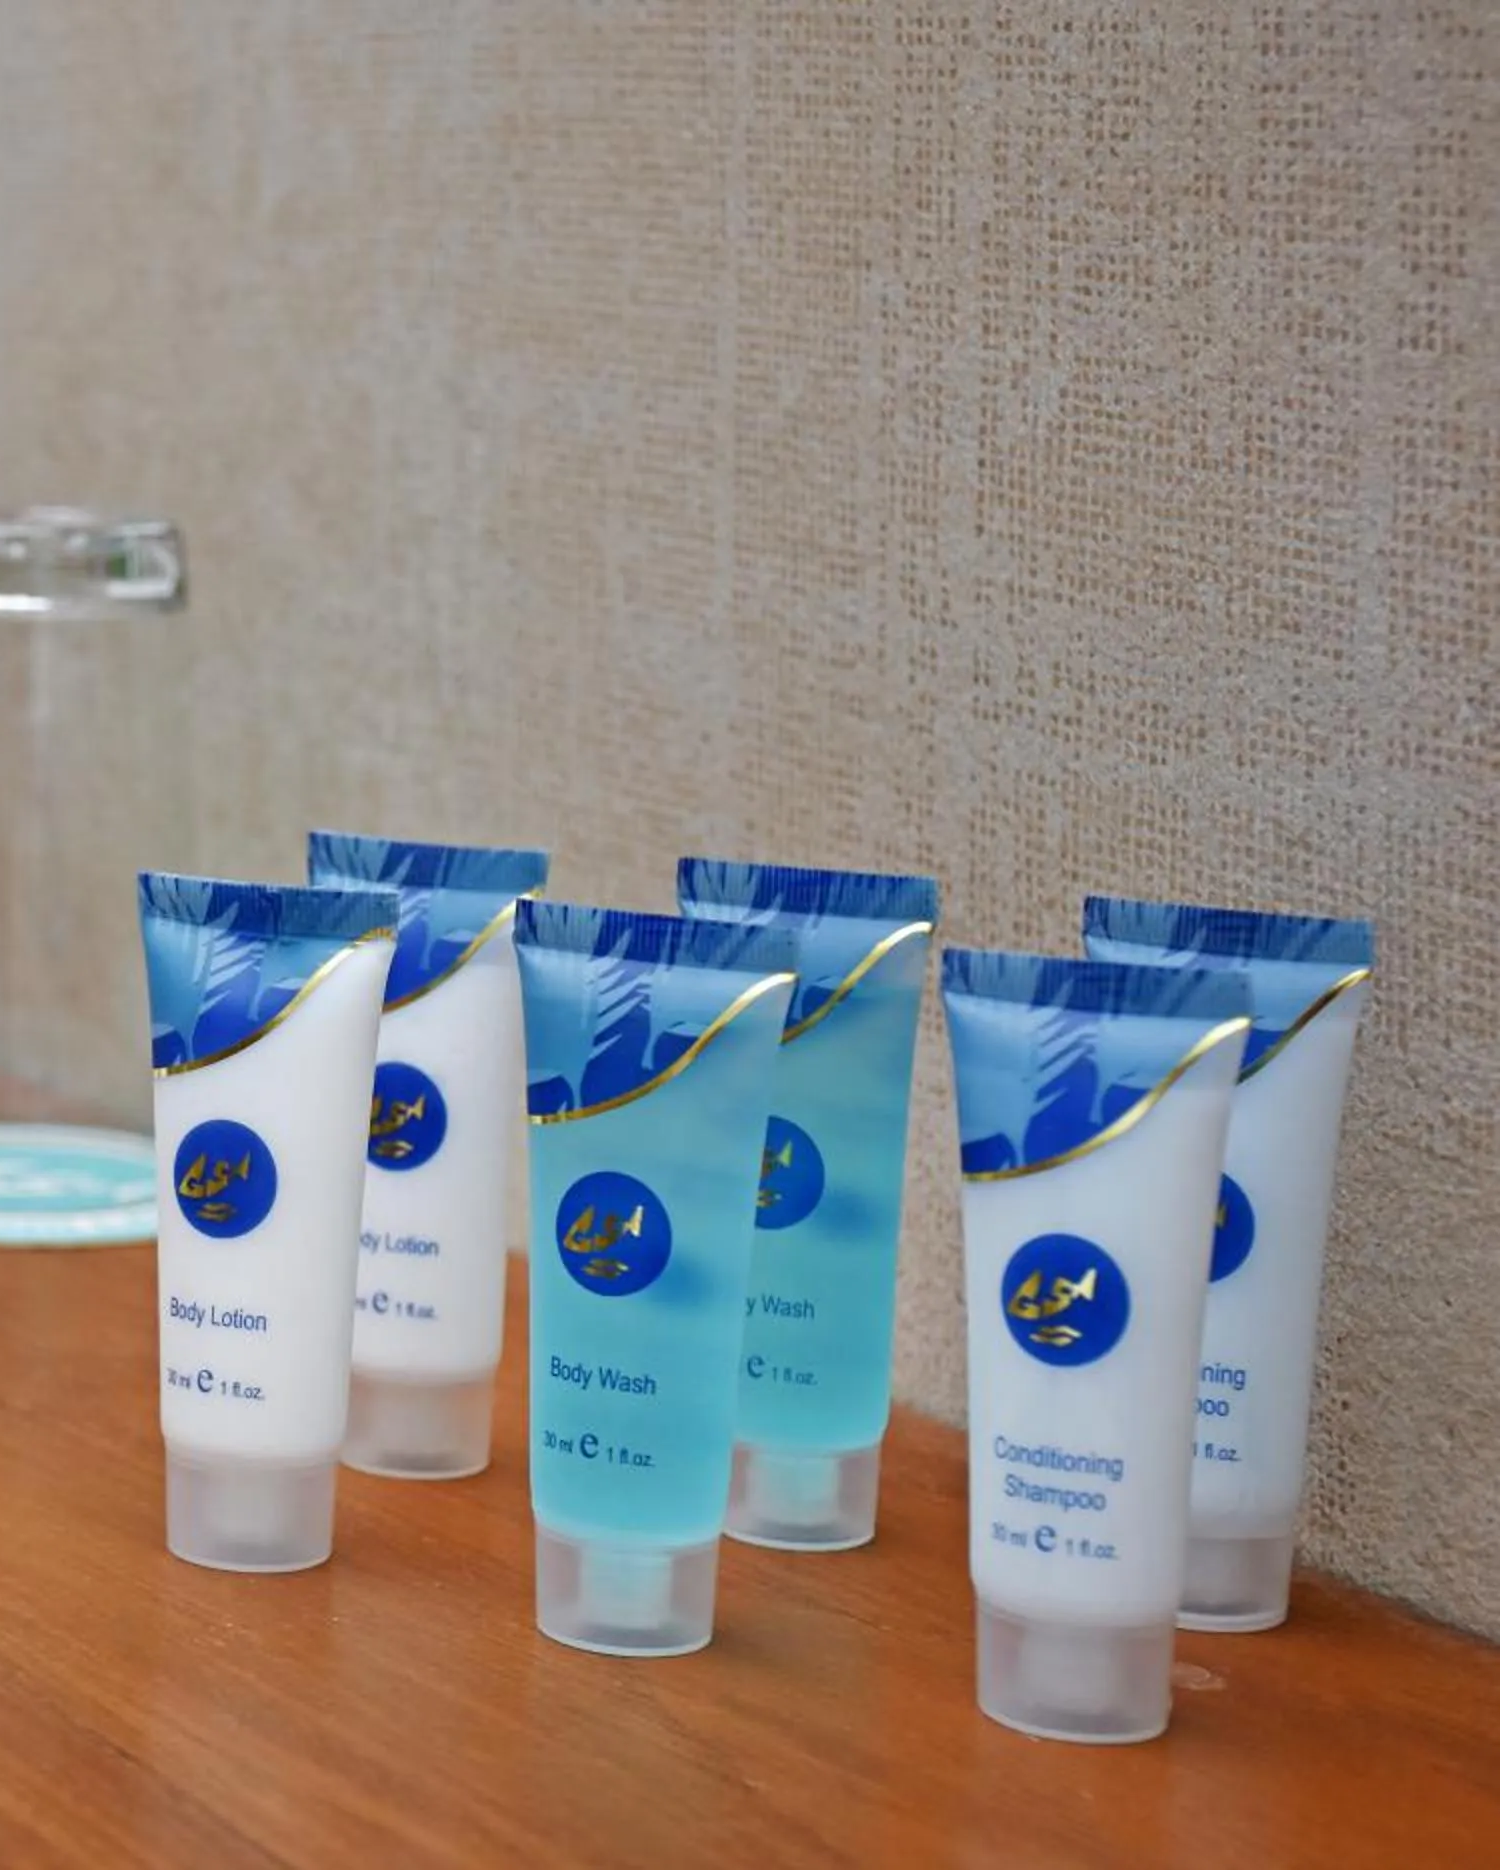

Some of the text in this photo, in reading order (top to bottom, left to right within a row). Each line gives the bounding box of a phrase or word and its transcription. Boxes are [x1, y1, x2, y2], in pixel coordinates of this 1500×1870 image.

[385, 1231, 440, 1258] Lotion
[169, 1296, 268, 1332] Body Lotion
[761, 1293, 815, 1320] Wash
[550, 1355, 657, 1395] Body Wash
[607, 1446, 614, 1463] 1
[995, 1436, 1124, 1483] Conditioning
[1004, 1473, 1107, 1514] Shampoo
